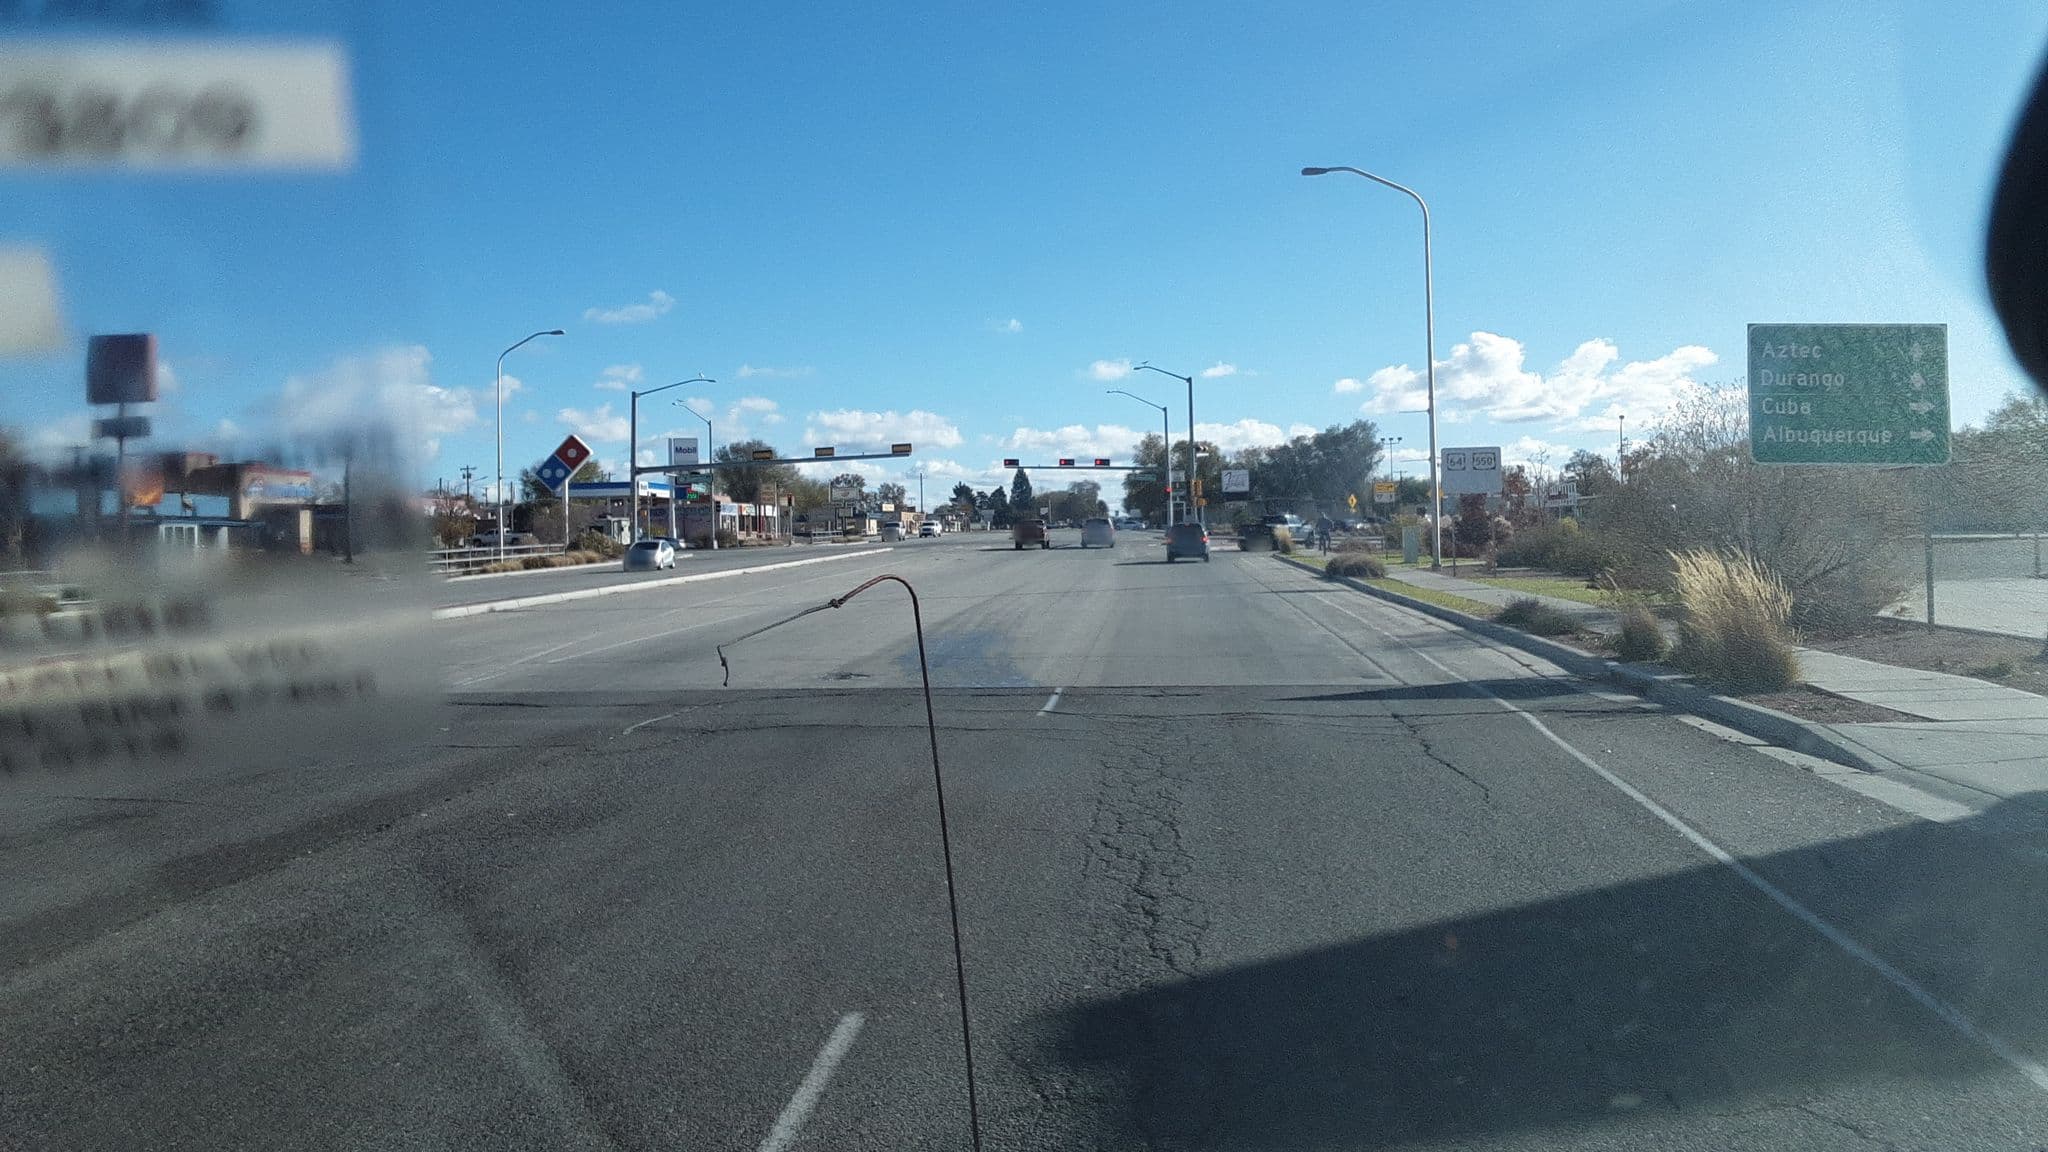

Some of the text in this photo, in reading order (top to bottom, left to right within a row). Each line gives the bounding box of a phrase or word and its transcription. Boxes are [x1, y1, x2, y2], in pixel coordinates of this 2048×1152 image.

[1761, 342, 1822, 358] Aztec
[1760, 369, 1845, 391] Durango
[1761, 398, 1811, 415] Cuba
[1763, 427, 1893, 446] Albuquerque
[675, 446, 697, 454] Mobil
[1449, 456, 1463, 467] 64
[1475, 456, 1493, 466] 550
